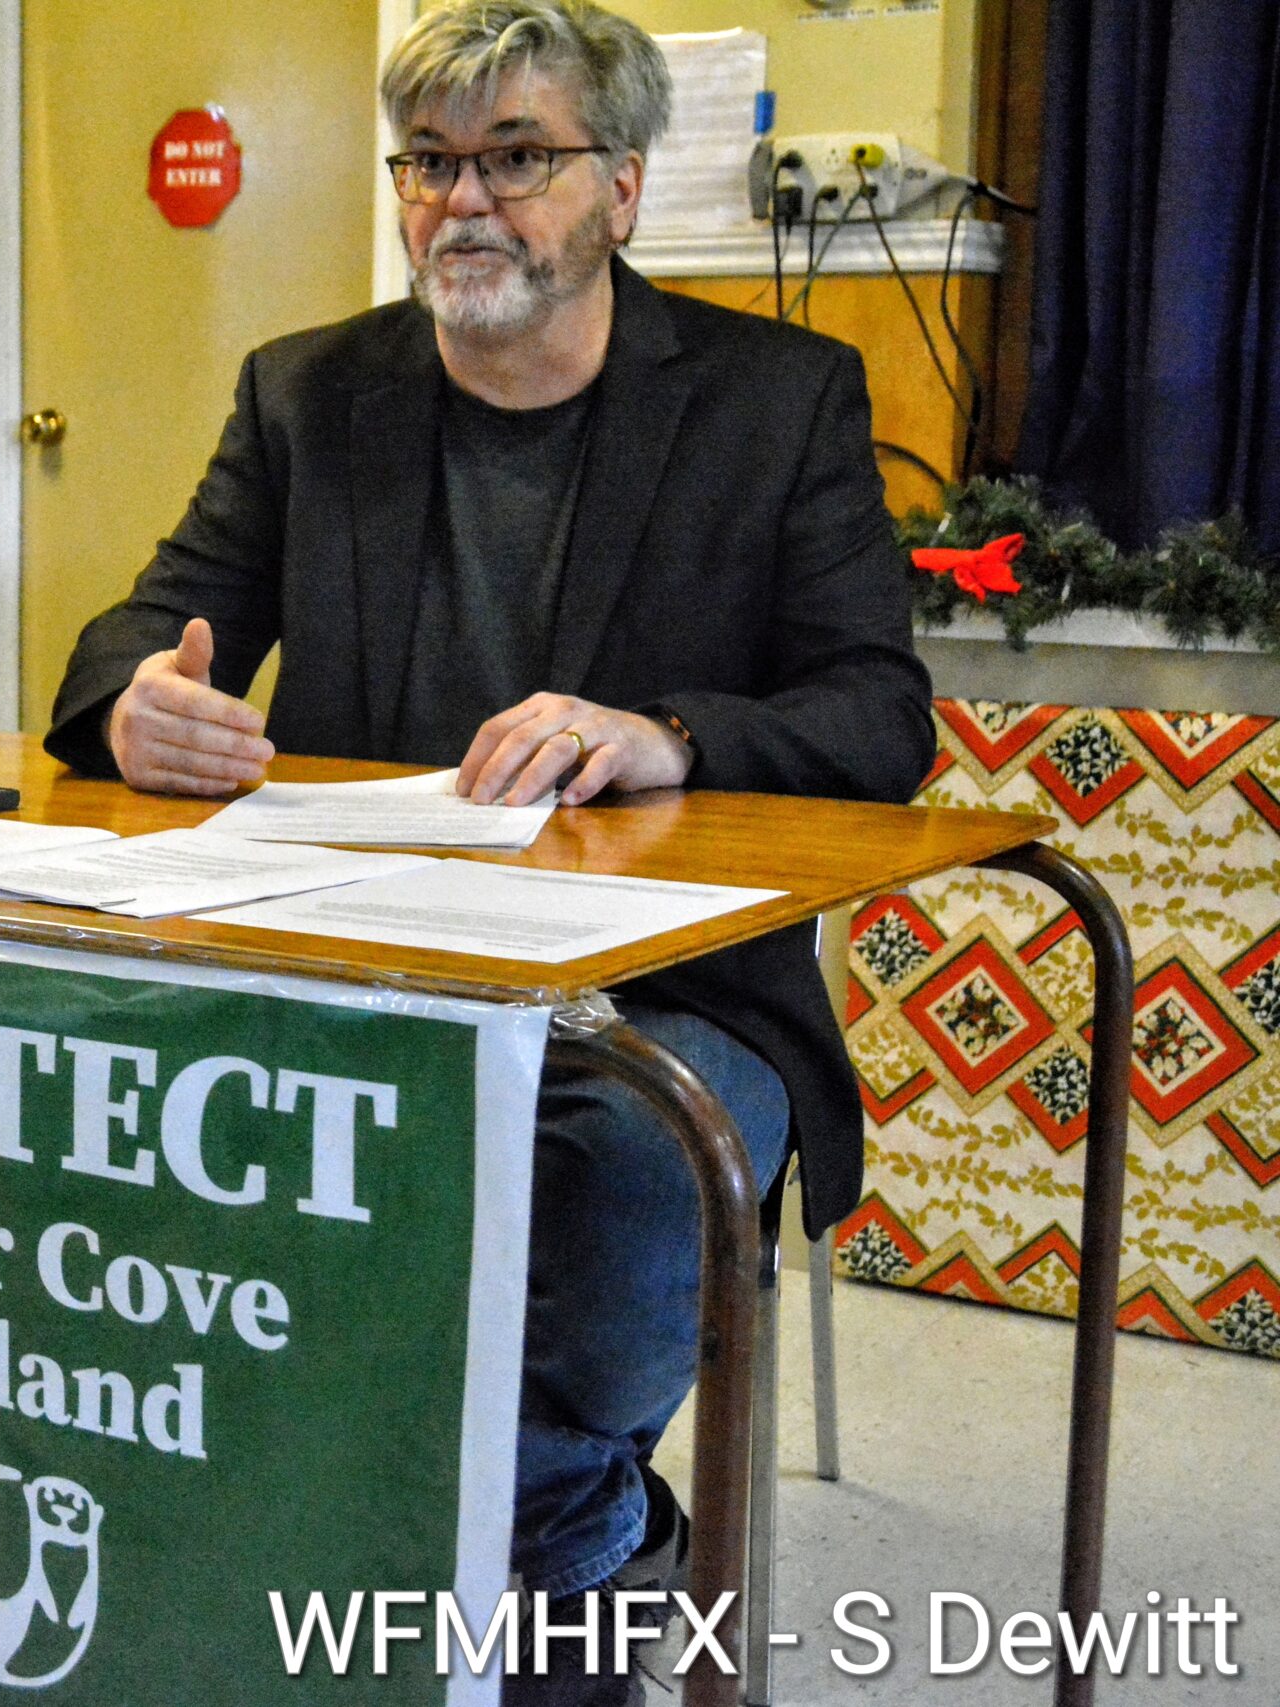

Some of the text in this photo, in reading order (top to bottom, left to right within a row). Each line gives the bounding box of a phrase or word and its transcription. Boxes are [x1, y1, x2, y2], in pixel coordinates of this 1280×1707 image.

[164, 140, 226, 160] DO NOT
[165, 167, 222, 187] ENTER
[37, 1222, 290, 1351] Cove
